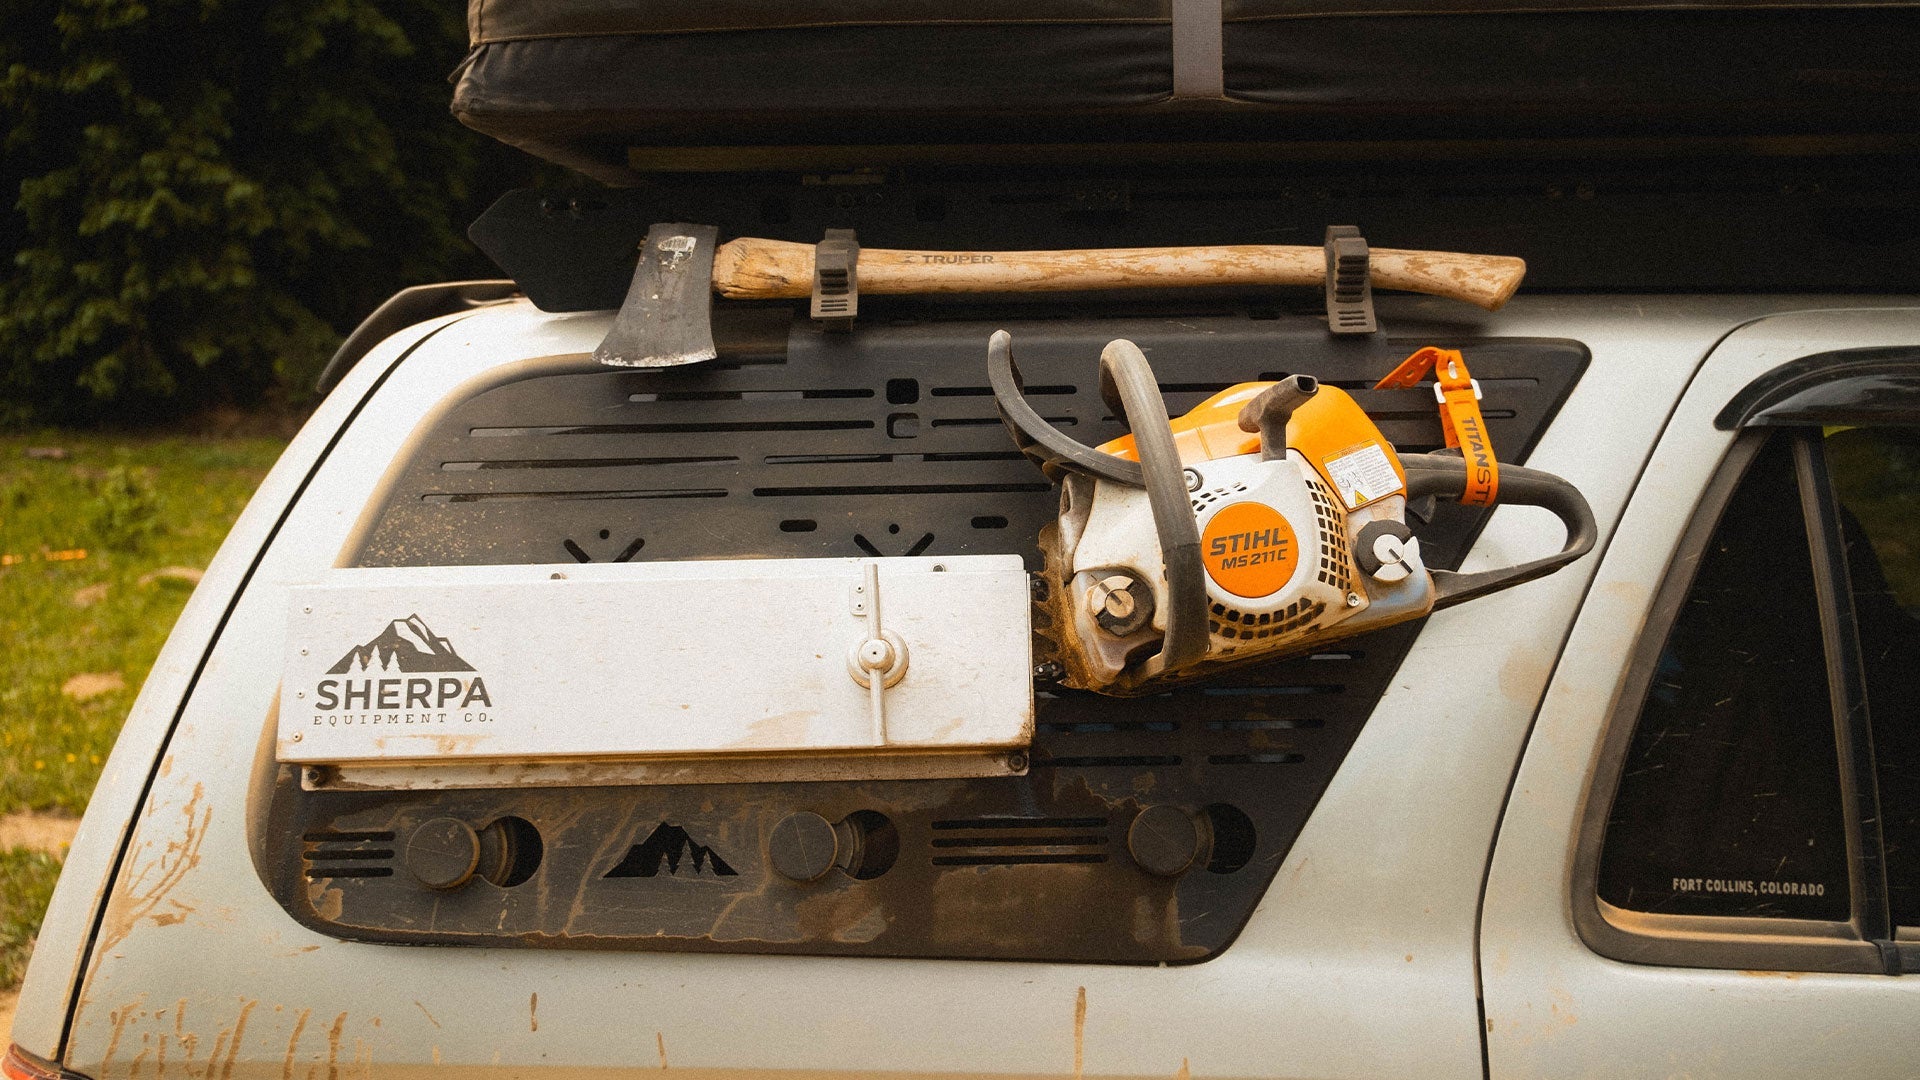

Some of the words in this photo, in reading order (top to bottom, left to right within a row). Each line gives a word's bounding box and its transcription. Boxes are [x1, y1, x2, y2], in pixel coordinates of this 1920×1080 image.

[921, 254, 995, 265] TRUPER
[1210, 527, 1289, 557] STIHL
[315, 677, 493, 711] SHERPA
[313, 712, 447, 727] EQUIPMENT
[464, 712, 494, 723] CO.
[1672, 877, 1702, 891] FORT
[1705, 879, 1758, 896] COLLINS,
[1760, 880, 1825, 897] COLORADO
